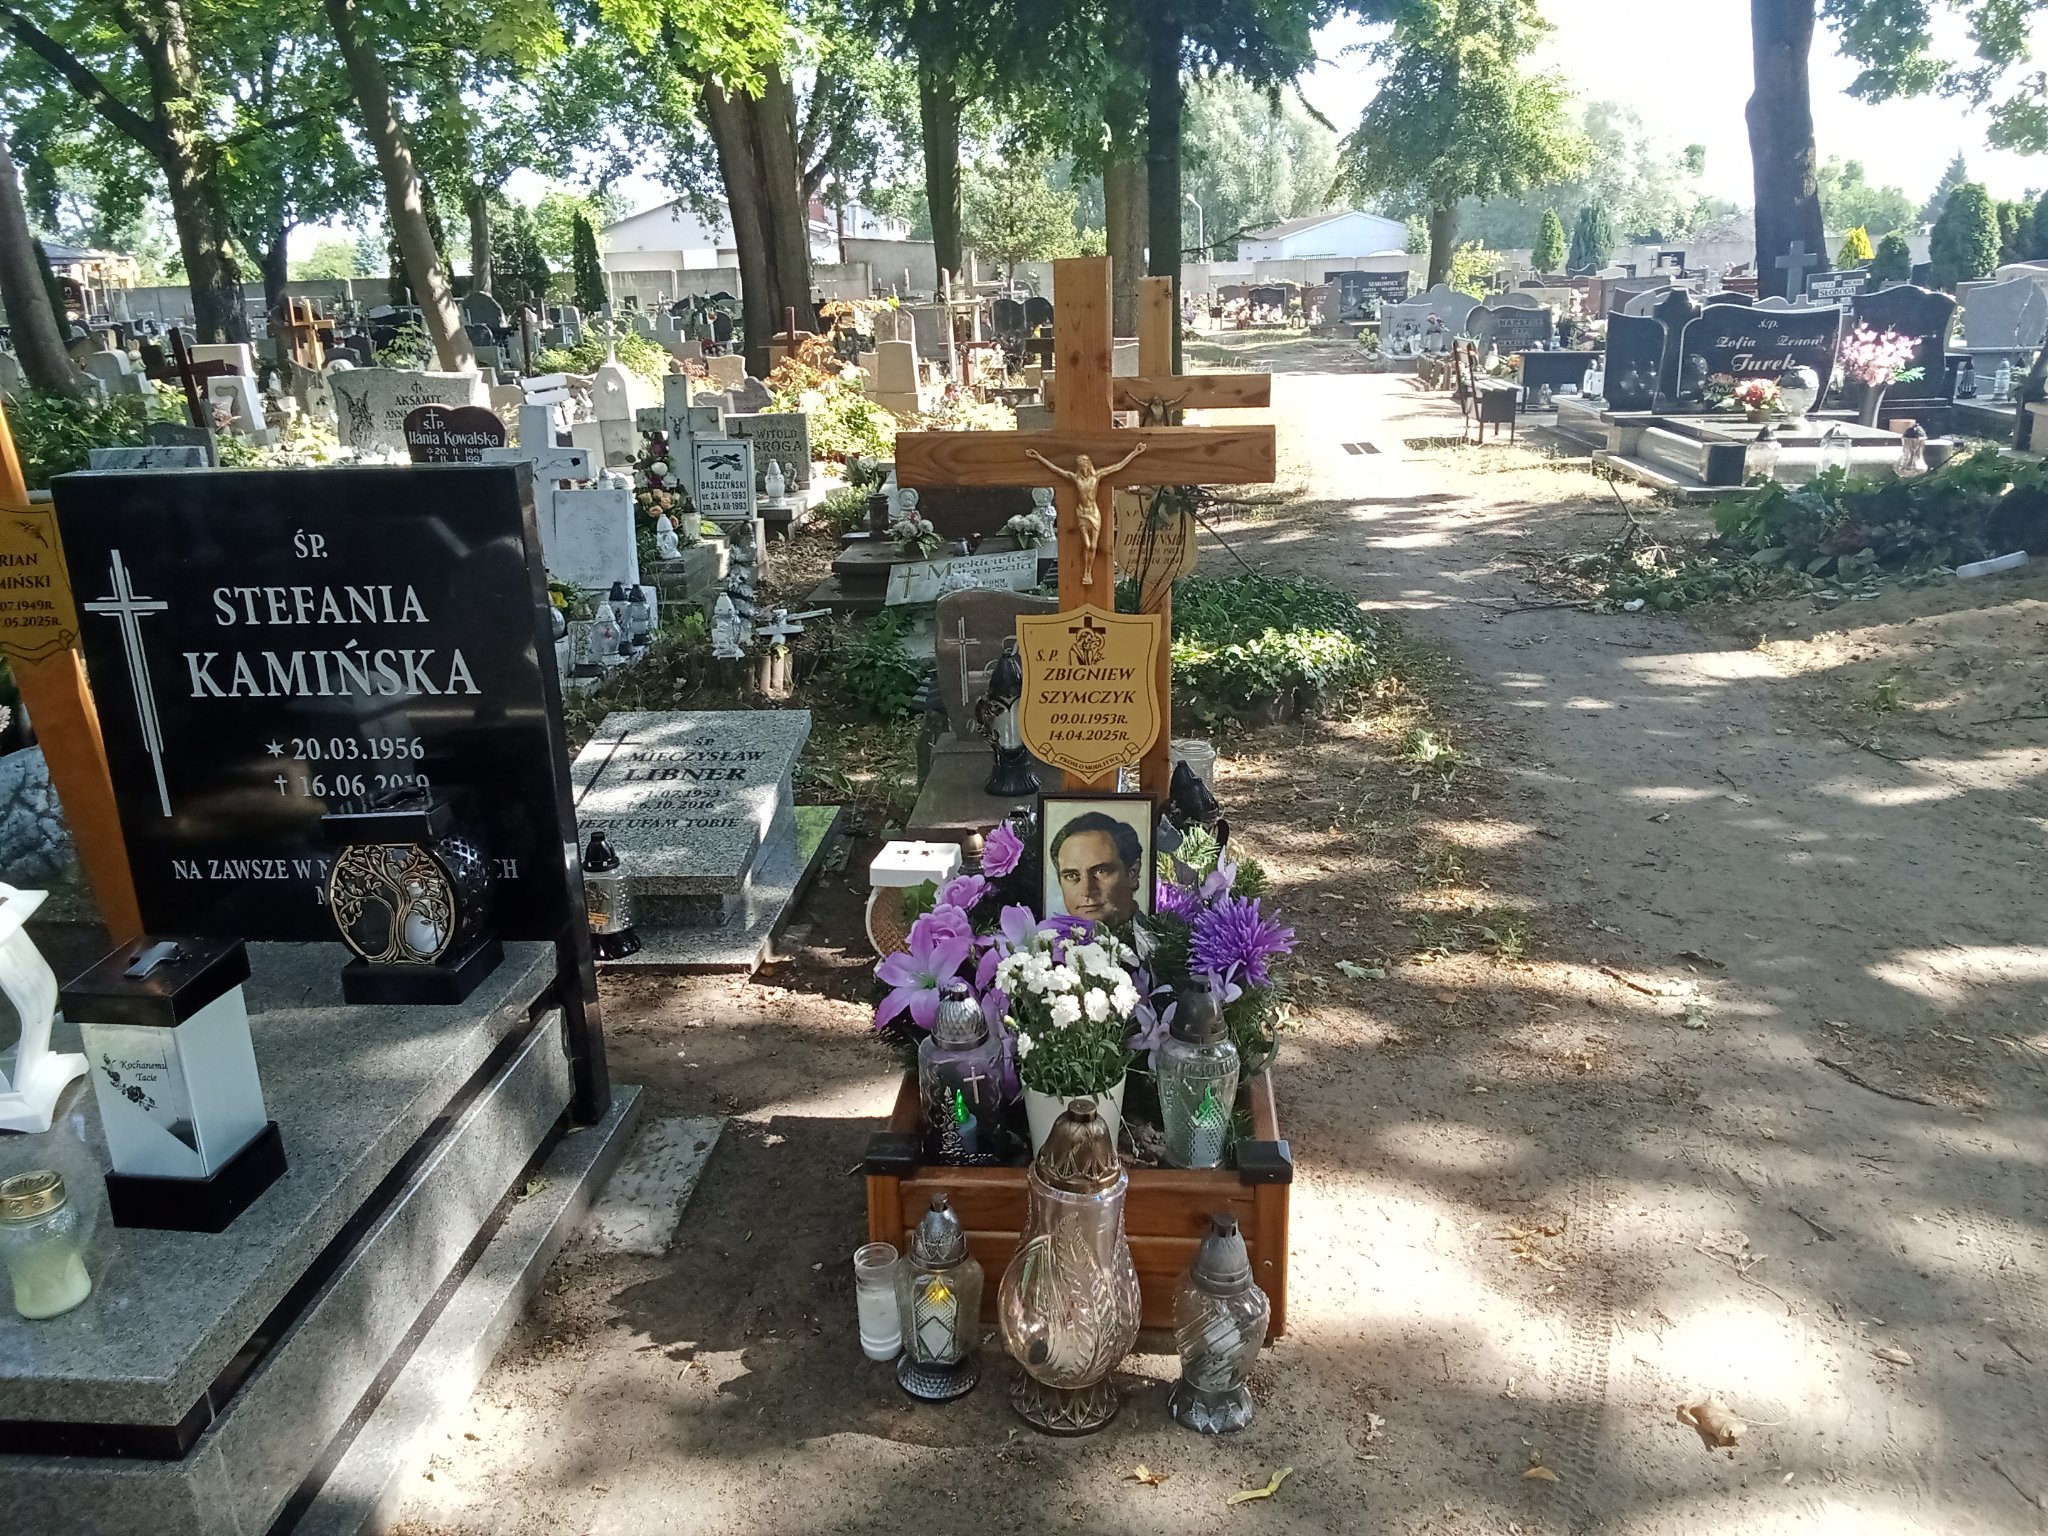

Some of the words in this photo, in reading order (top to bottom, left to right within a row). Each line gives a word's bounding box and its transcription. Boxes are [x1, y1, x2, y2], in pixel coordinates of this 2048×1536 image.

[1714, 335, 1757, 350] Zofia
[1731, 352, 1797, 372] Turek
[408, 430, 441, 446] Hania
[443, 431, 499, 447] Kowalska
[756, 429, 798, 440] WITOLD
[700, 480, 747, 490] BASZCZYŃSKI
[294, 529, 328, 558] ŚP.
[213, 584, 430, 626] STEFANIA
[182, 638, 482, 698] KAMIŃSKA
[1043, 667, 1136, 681] ZBIGNIEW
[1038, 690, 1137, 704] SZYMCZYK
[291, 736, 426, 760] 20.03.1956
[627, 750, 766, 763] MIECZYSŁAW
[622, 767, 748, 781] LIBNER
[577, 818, 622, 830] JEZU
[627, 817, 679, 829] UFAM
[685, 817, 740, 829] TOBIE
[172, 859, 204, 880] NA
[207, 859, 290, 880] ZAWSZE
[292, 859, 312, 879] W
[118, 1059, 168, 1071] Kochanemu
[135, 1072, 158, 1082] Tacie
